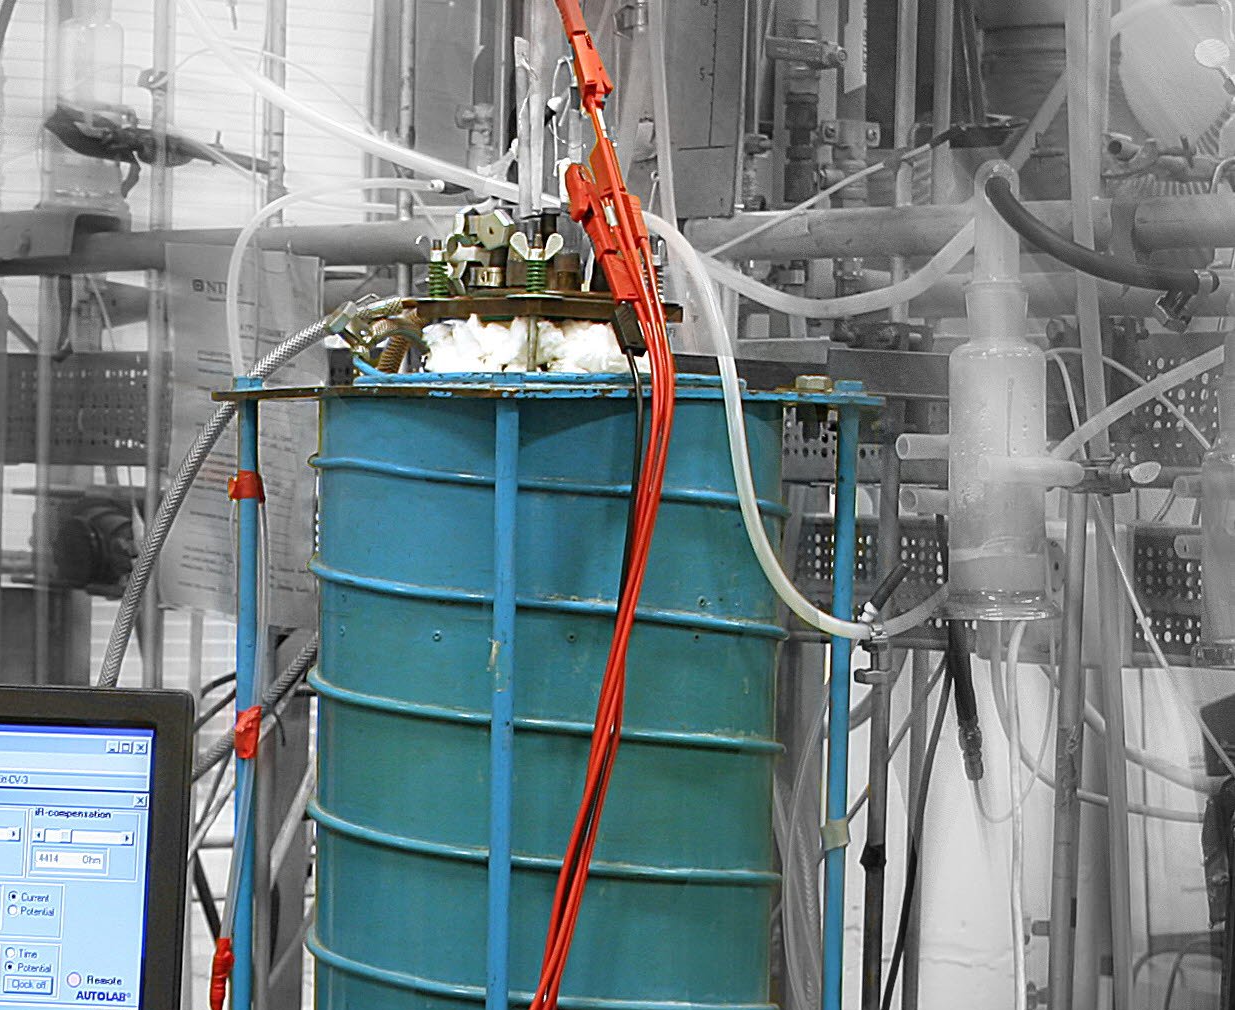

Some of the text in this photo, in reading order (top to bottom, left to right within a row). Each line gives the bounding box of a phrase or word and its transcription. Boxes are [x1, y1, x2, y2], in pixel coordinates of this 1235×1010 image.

[82, 855, 101, 865] Ohm
[21, 893, 50, 903] Current
[20, 907, 55, 917] Potential
[19, 949, 38, 959] Time
[17, 963, 52, 973] Potential
[11, 980, 34, 990] Clock
[86, 976, 122, 986] Remote
